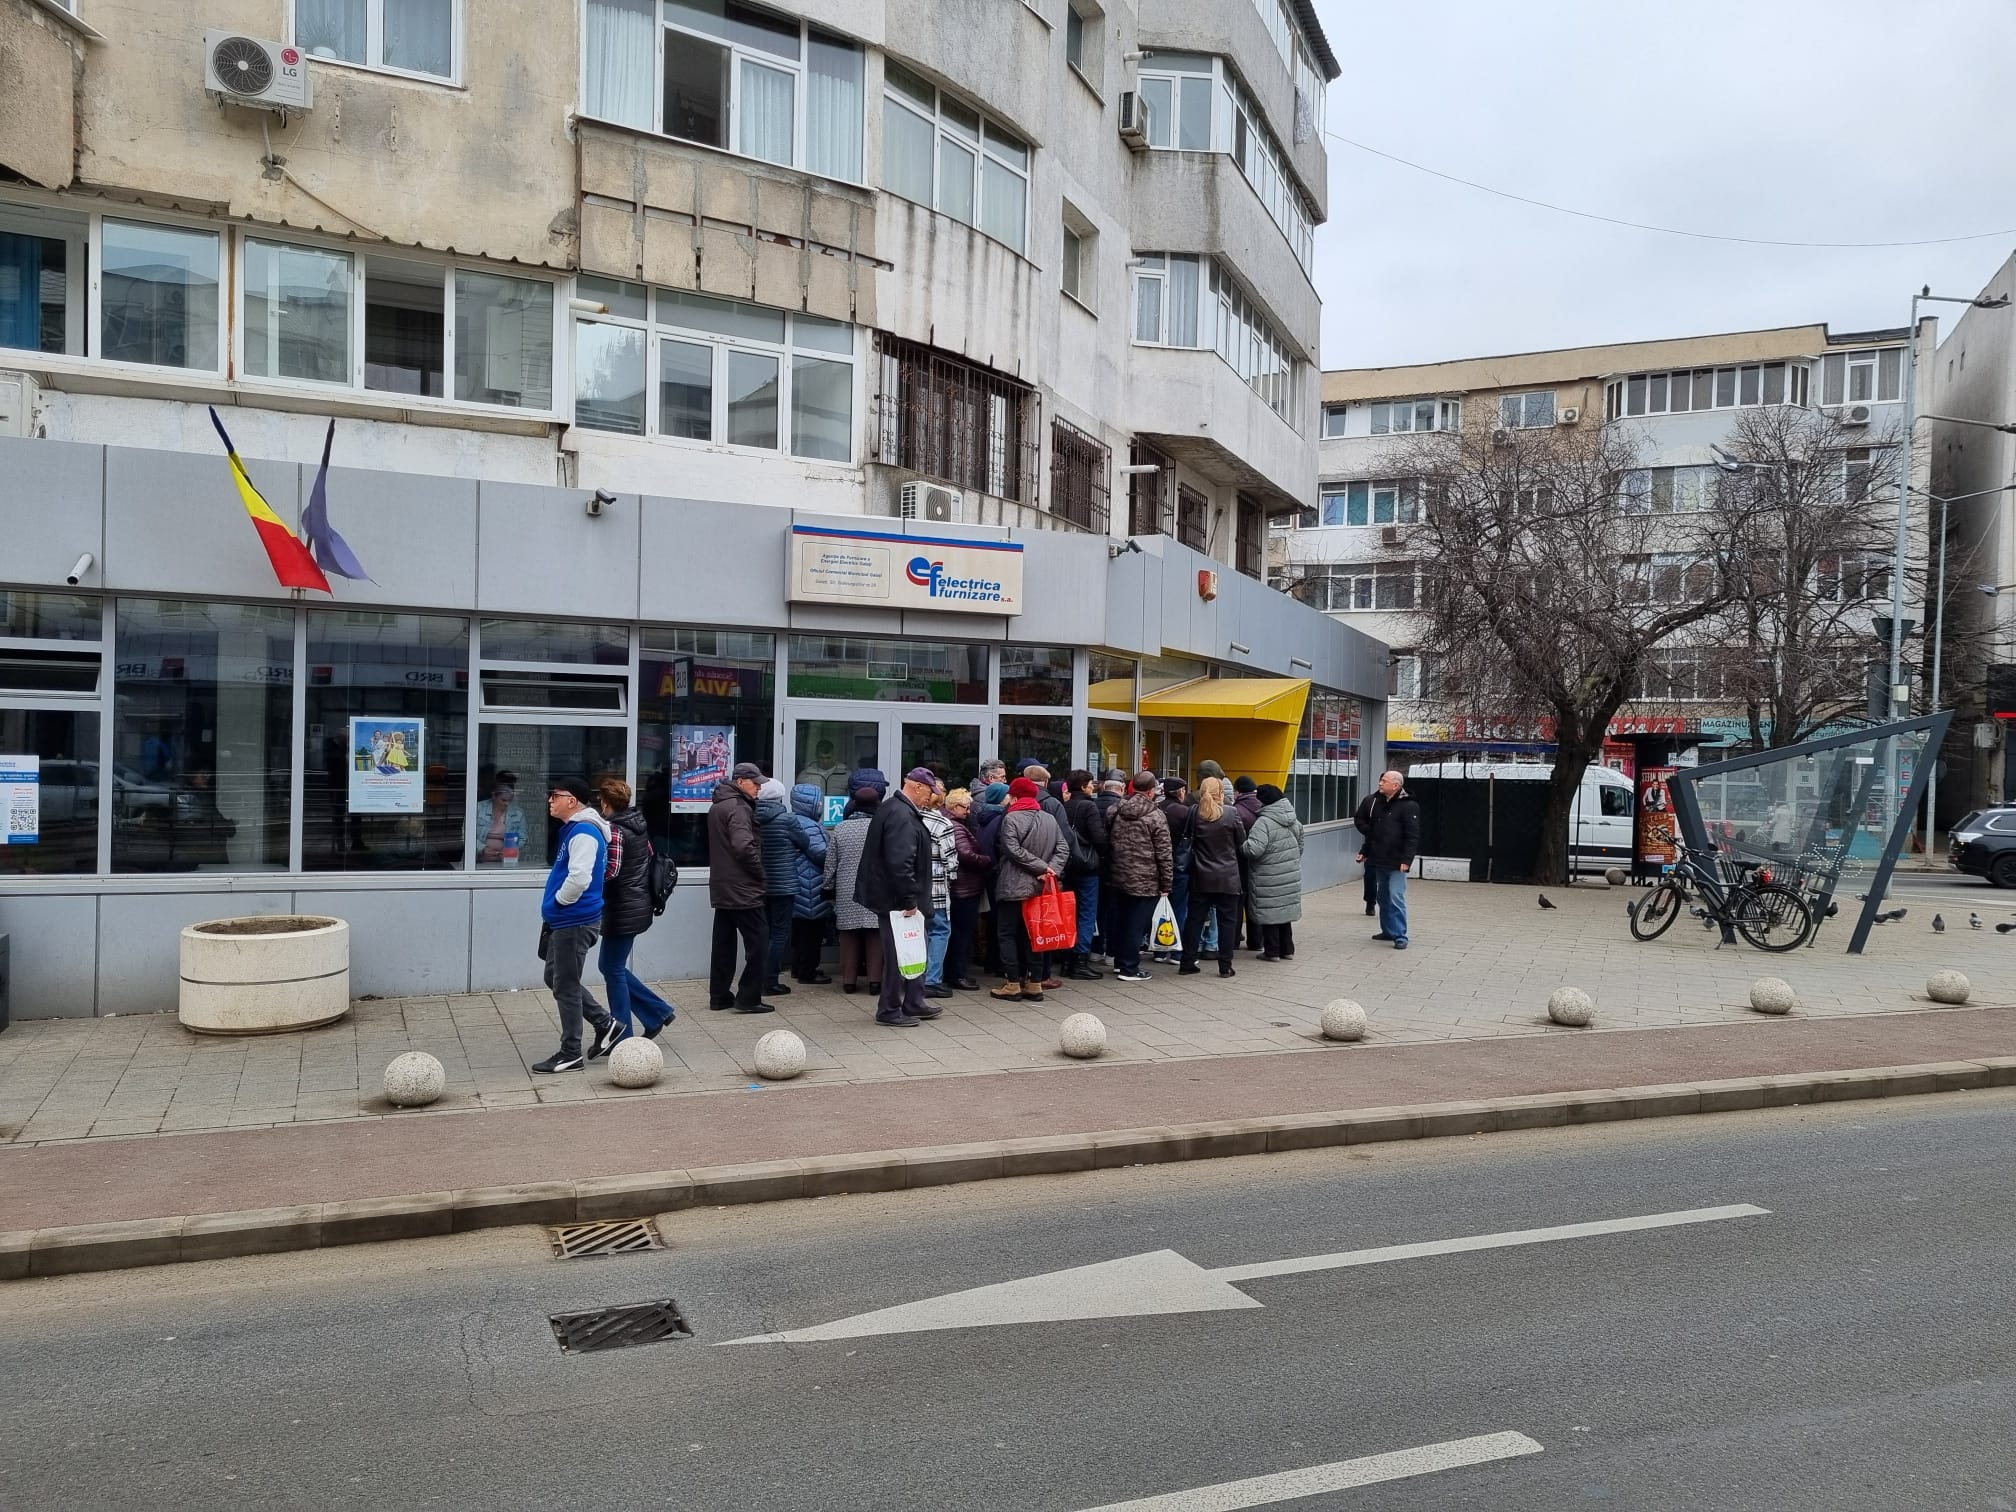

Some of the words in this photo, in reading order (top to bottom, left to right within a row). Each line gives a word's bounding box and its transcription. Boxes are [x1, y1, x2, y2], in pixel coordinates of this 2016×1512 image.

[282, 66, 297, 77] LG
[938, 576, 1001, 591] electrica
[939, 587, 1001, 602] furnizare
[1046, 933, 1066, 944] profi
